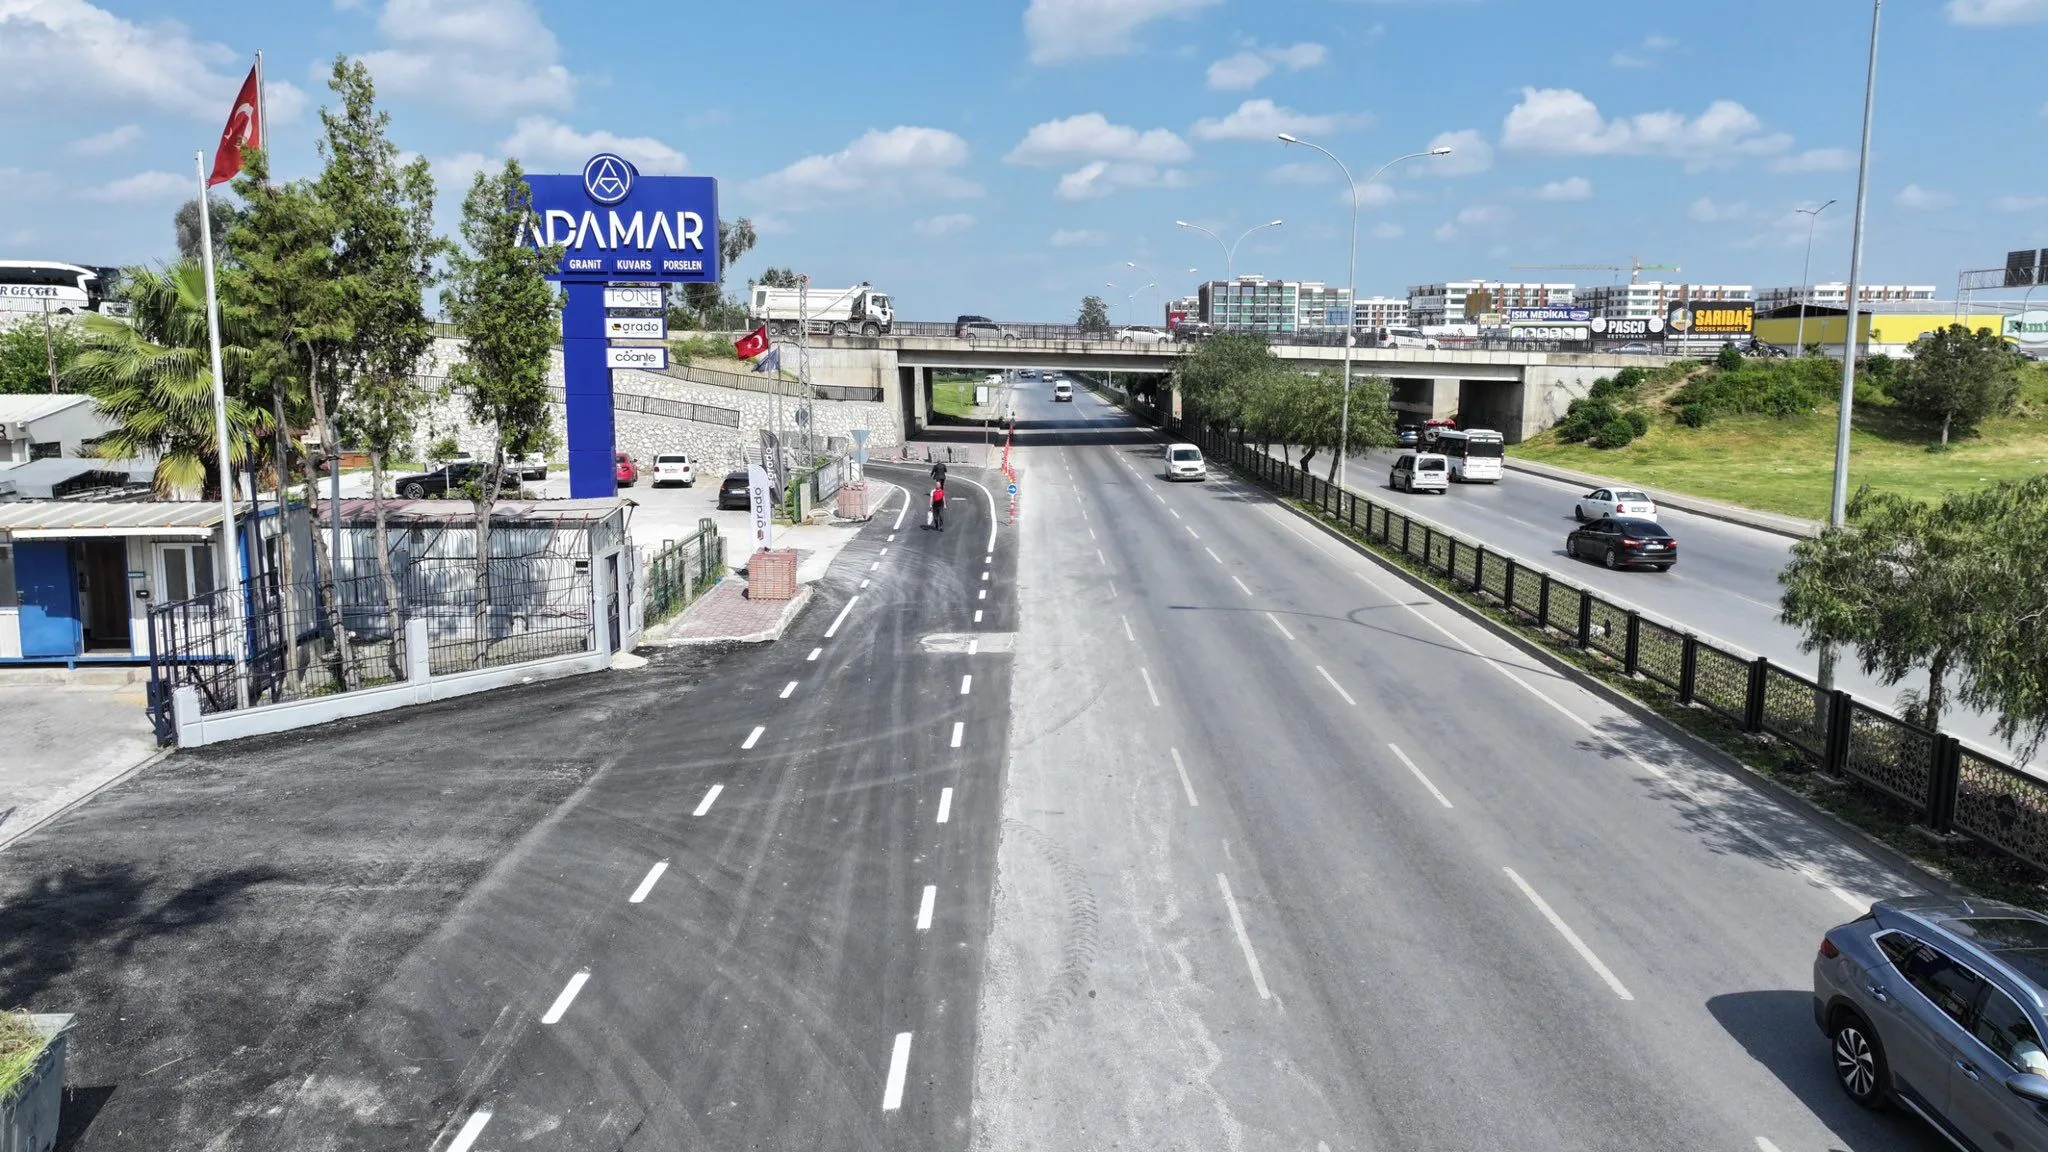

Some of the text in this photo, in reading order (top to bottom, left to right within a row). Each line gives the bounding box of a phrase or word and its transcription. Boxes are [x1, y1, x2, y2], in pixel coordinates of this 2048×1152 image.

[514, 209, 704, 250] ADAMAR
[617, 259, 651, 270] KUVARS
[663, 260, 702, 270] PORSELEN
[609, 289, 658, 302] T-ONE
[622, 322, 659, 334] grado
[1609, 321, 1646, 334] PASCO
[756, 487, 767, 529] grado
